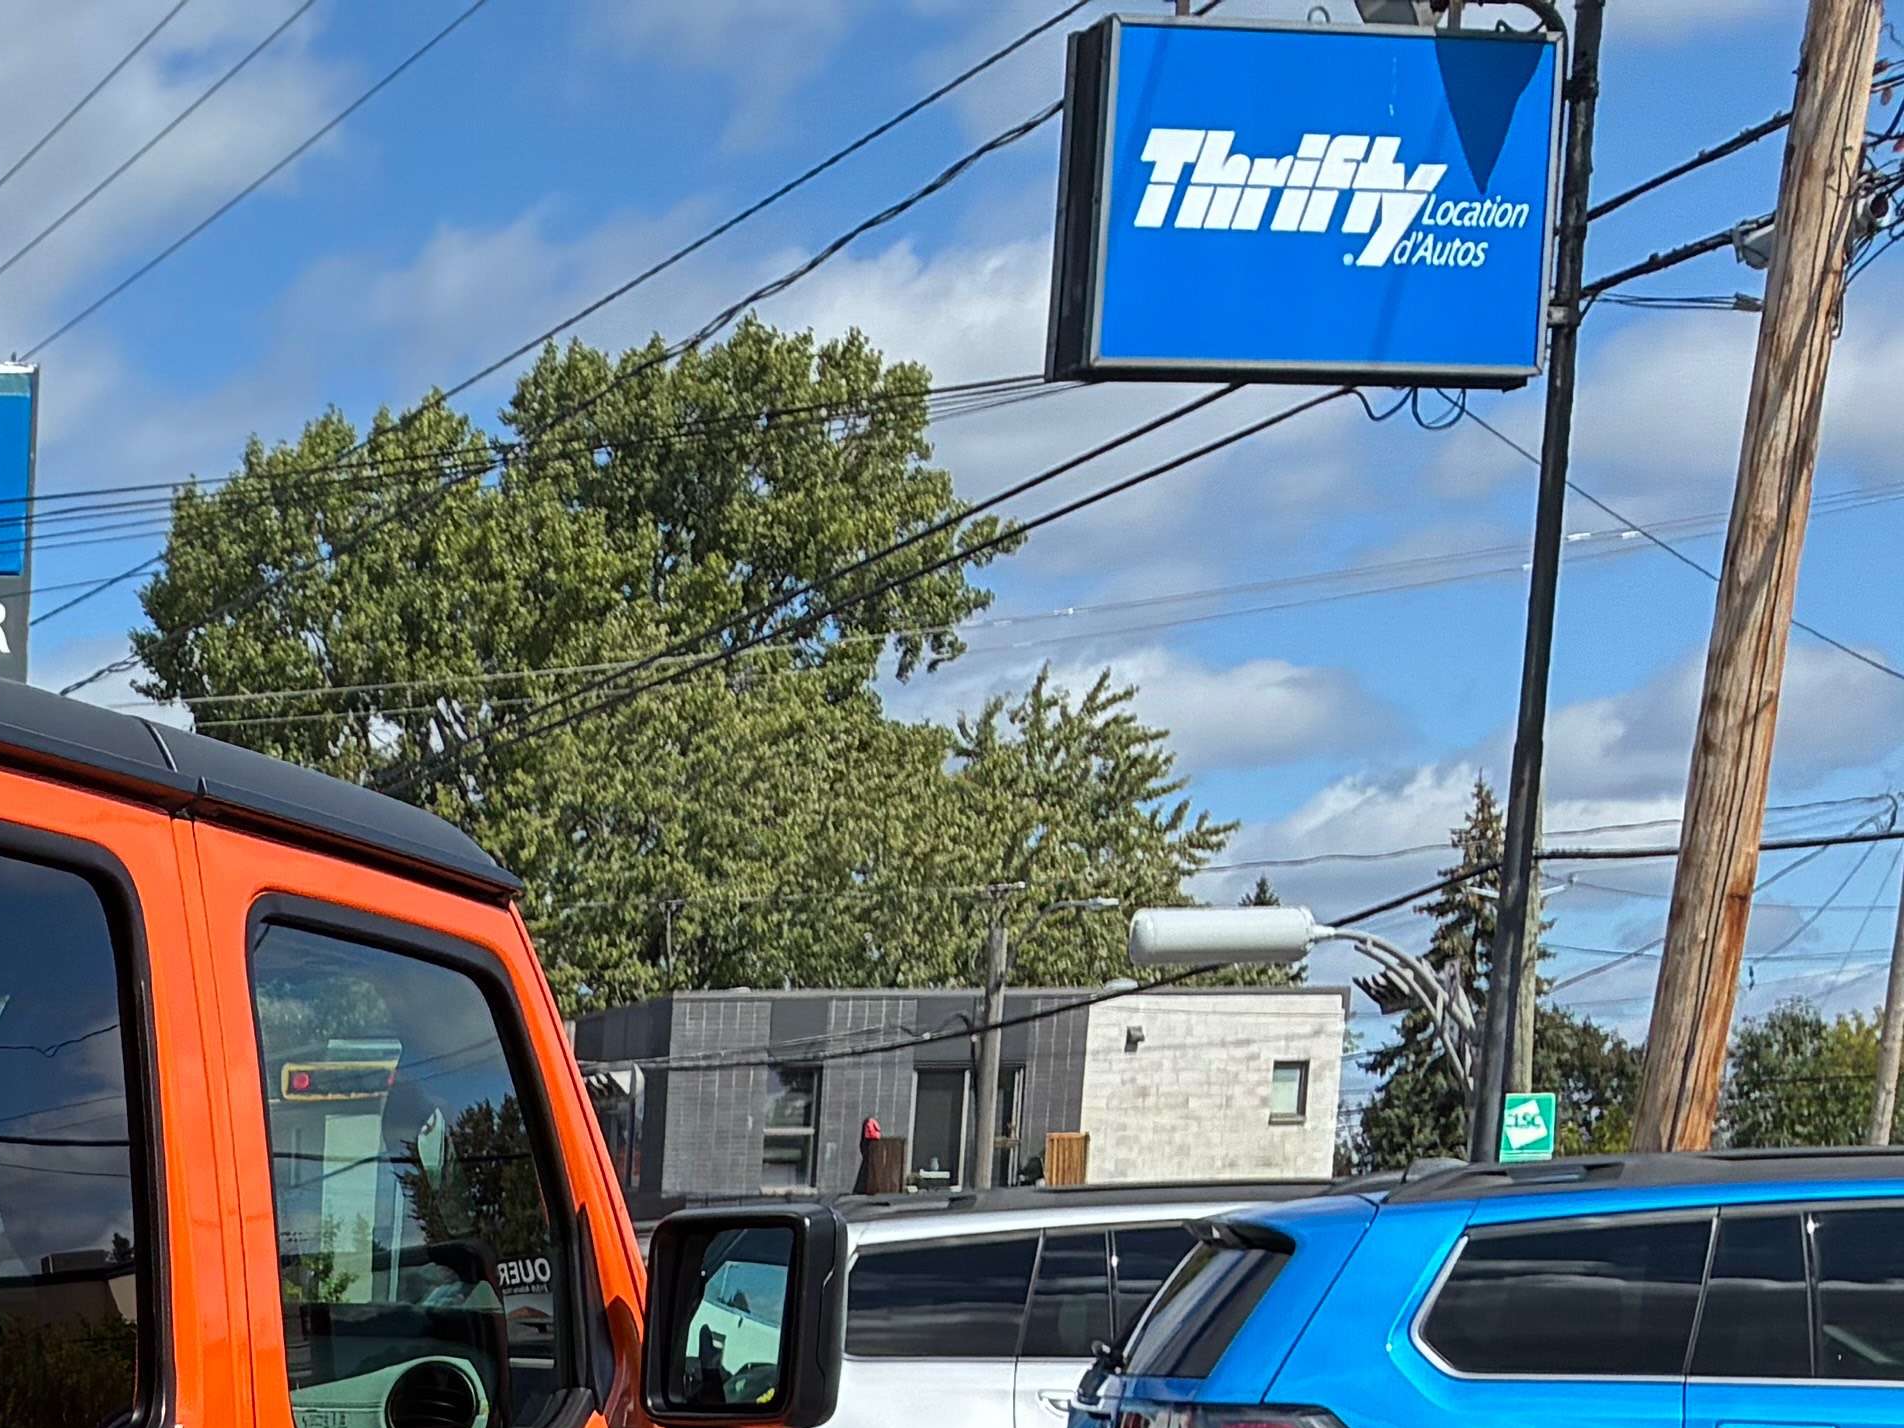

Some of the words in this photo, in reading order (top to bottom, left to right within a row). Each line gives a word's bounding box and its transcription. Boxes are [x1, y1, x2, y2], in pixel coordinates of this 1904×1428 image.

[1133, 127, 1448, 268] Thrifty
[1423, 195, 1529, 230] Location
[1394, 236, 1488, 268] d'Autos
